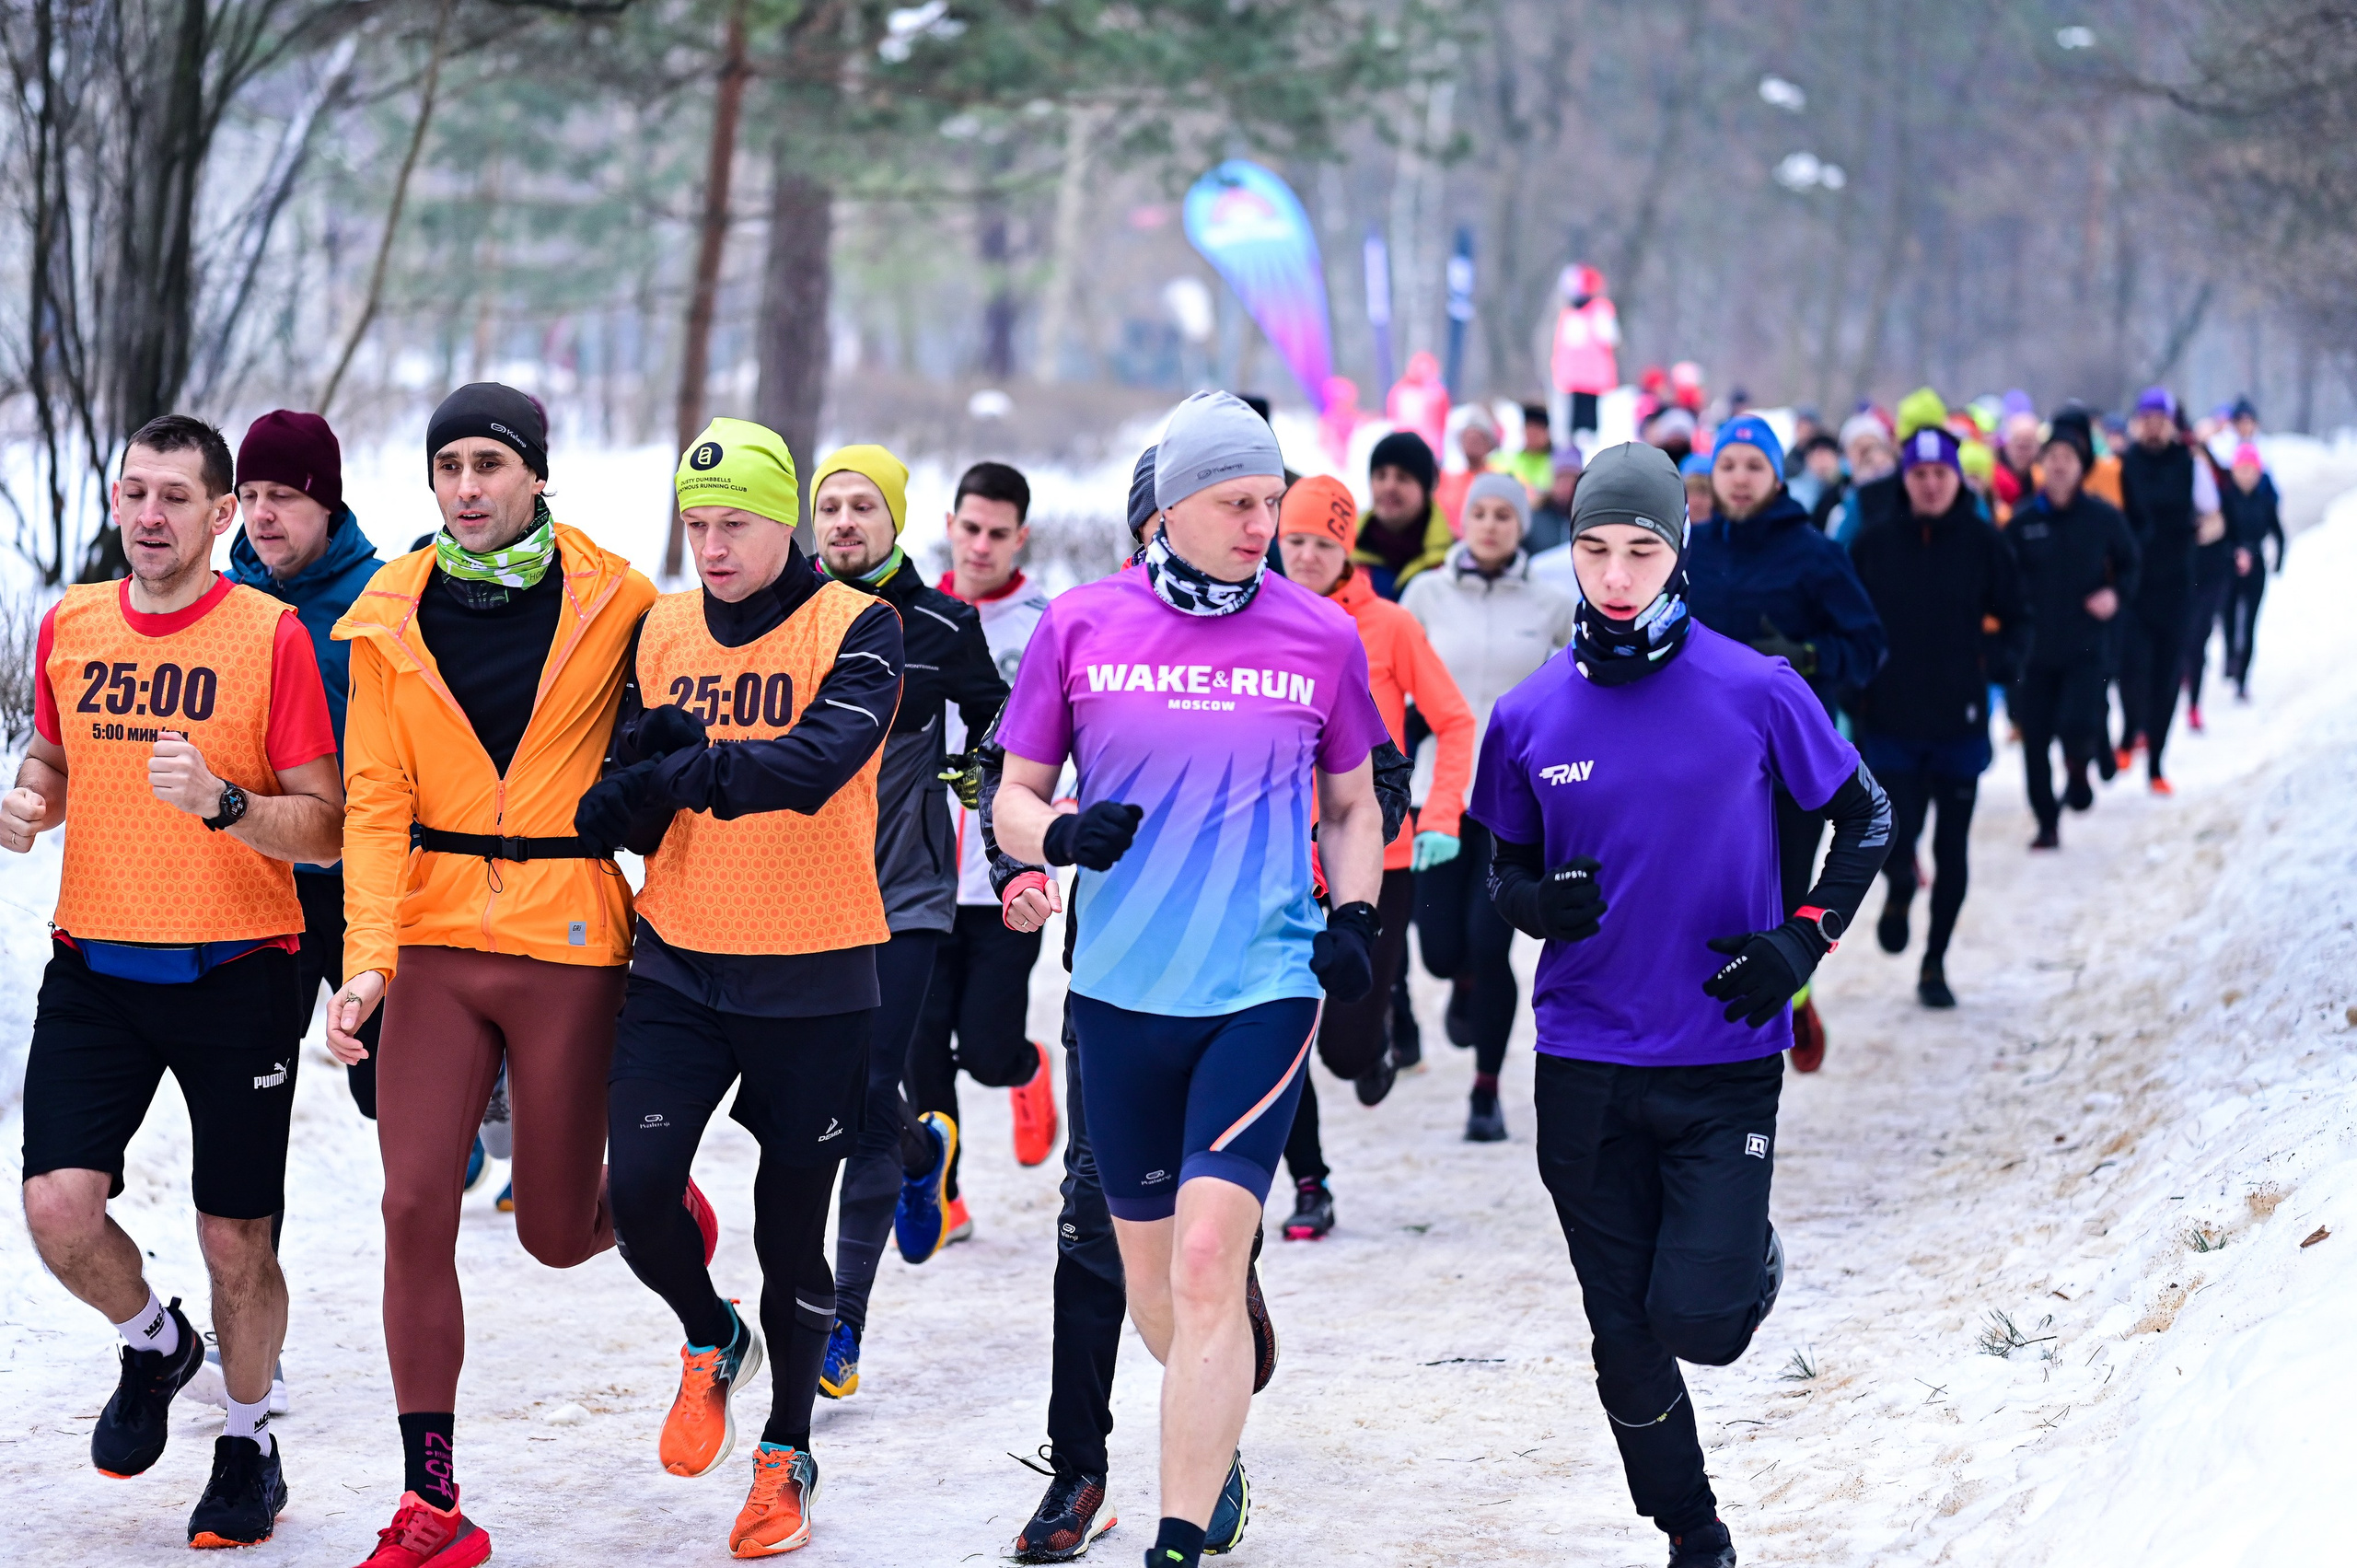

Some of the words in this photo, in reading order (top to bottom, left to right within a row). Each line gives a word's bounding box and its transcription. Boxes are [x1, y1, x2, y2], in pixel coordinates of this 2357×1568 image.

[76, 661, 217, 721] 25:00
[669, 672, 793, 726] 25:00
[1167, 699, 1236, 712] MOSCOW
[92, 723, 124, 740] 5:00
[1538, 760, 1595, 786] RAY
[253, 1071, 284, 1089] PUMA
[818, 1127, 844, 1143] DEMIX
